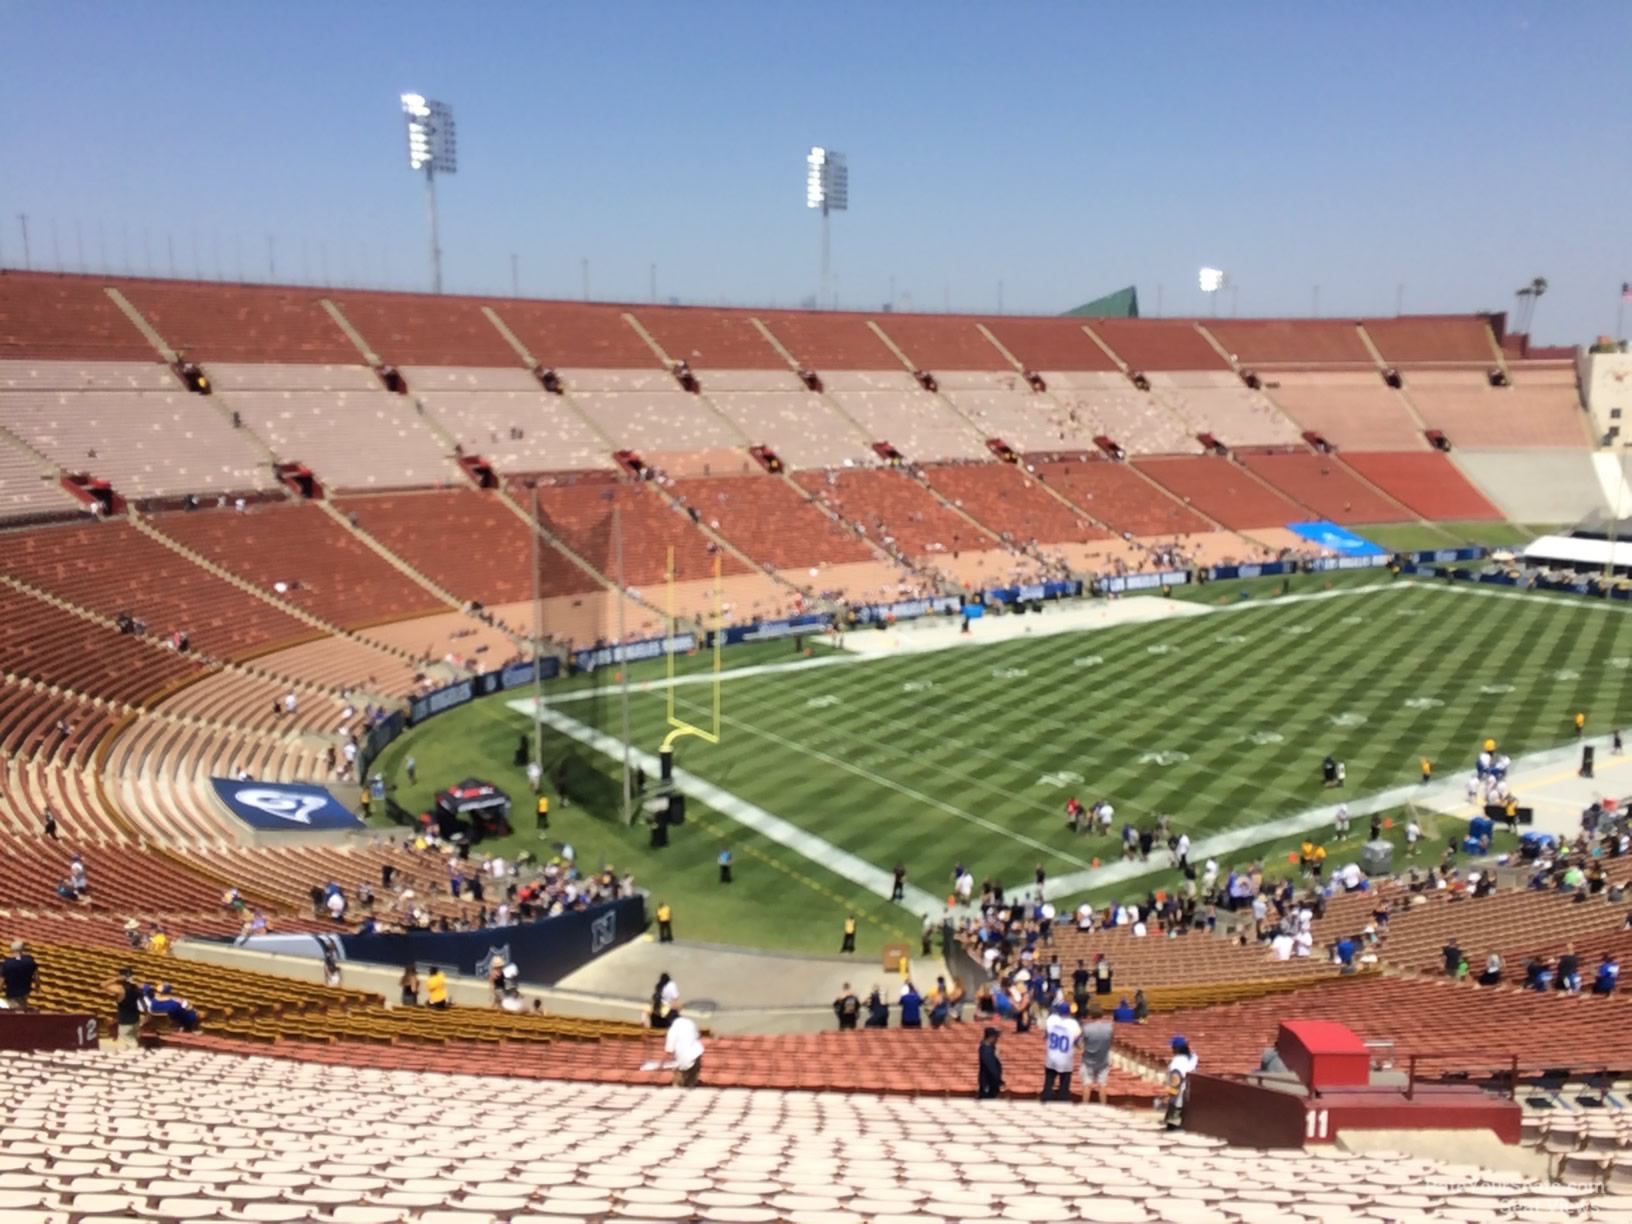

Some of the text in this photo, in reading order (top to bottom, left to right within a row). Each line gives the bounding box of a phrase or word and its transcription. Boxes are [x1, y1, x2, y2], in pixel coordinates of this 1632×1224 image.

[77, 1018, 97, 1046] 12
[1049, 1032, 1070, 1053] 90
[1305, 1109, 1329, 1138] 11
